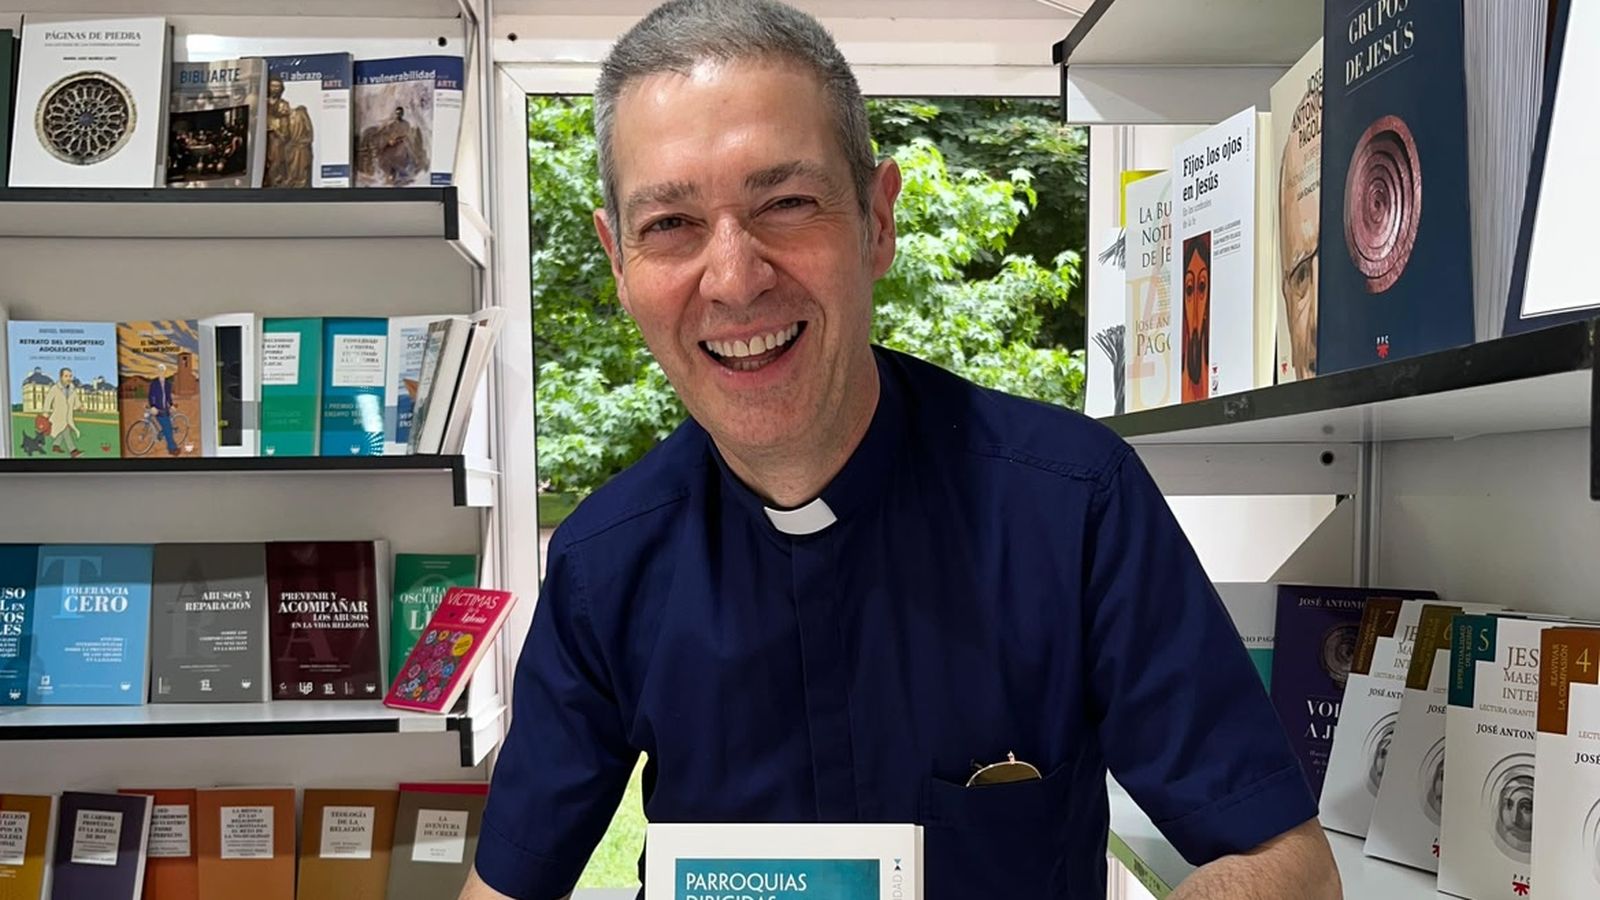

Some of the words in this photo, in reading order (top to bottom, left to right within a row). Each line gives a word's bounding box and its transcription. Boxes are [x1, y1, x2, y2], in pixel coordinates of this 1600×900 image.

[45, 28, 86, 40] PÁGINAS
[89, 31, 101, 40] DE
[105, 31, 141, 40] PIEDRA
[1346, 51, 1364, 85] DE
[1366, 19, 1414, 72] JESÚS
[180, 68, 241, 84] BIBLIARTE
[291, 71, 322, 81] abrazo
[369, 70, 436, 83] vulnerabilidad
[323, 80, 342, 88] ARTE
[437, 80, 457, 88] ARTE
[1183, 154, 1204, 178] Fijos
[1206, 146, 1220, 167] los
[1222, 136, 1242, 161] ojos
[1183, 185, 1194, 201] en
[1195, 170, 1219, 201] Jesús
[1139, 207, 1153, 224] LA
[1142, 223, 1172, 246] NOTI
[1142, 250, 1157, 268] DE
[66, 586, 129, 595] TOLERANCIA
[202, 591, 242, 600] ABUSOS
[245, 590, 252, 600] Y
[281, 592, 329, 600] PREVENIR
[330, 592, 338, 600] Y
[64, 595, 128, 613] CERO
[185, 599, 252, 611] REPARACIÓN
[278, 598, 368, 613] ACOMPAÑAR
[448, 589, 500, 609] VÍCTIMAS
[1299, 596, 1322, 607] JOSÉ
[0, 612, 24, 624] OS
[313, 613, 331, 621] LOS
[334, 613, 369, 621] ABUSOS
[1385, 610, 1396, 629] 7
[0, 624, 22, 636] ES
[1457, 625, 1466, 689] ESPIRITUALIDAD
[1503, 646, 1539, 671] JES
[1550, 643, 1560, 686] REAVIVAR
[1575, 647, 1592, 673] 4
[1558, 644, 1568, 698] COMPASIÓN
[1479, 704, 1507, 714] LECTURA
[1304, 722, 1318, 738] A
[1476, 723, 1498, 735] JOSÉ
[331, 810, 367, 818] TEOLOGÍA
[686, 872, 807, 891] PARROQUIAS
